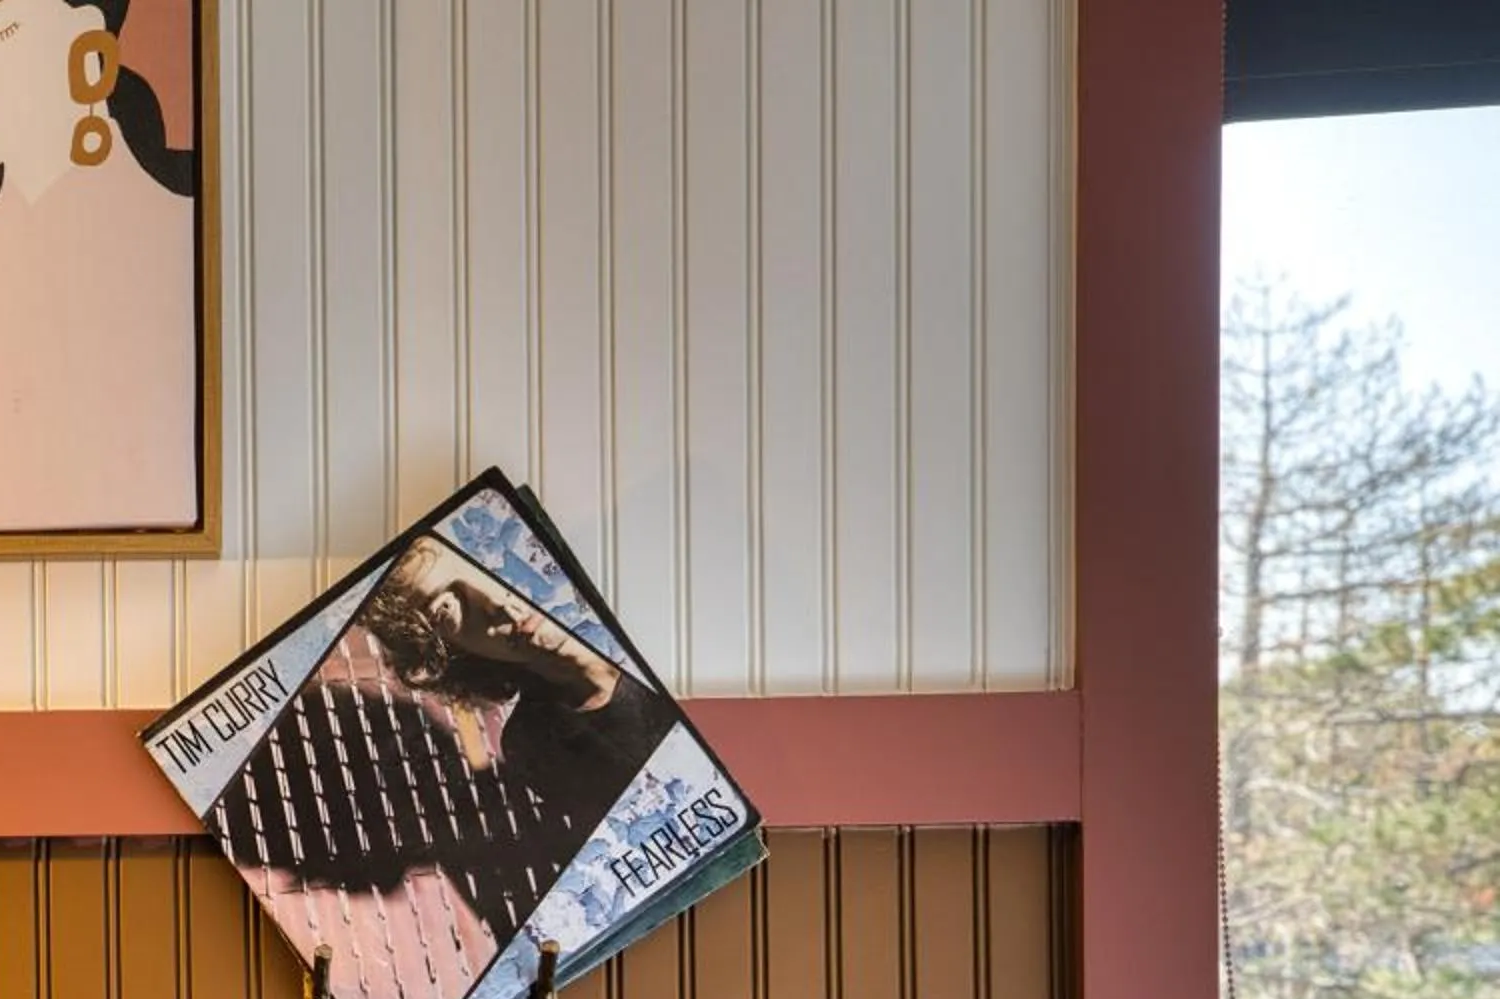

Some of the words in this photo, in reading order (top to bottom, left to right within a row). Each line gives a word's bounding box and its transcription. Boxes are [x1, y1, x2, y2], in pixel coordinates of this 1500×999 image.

[156, 719, 213, 774] TIM
[200, 658, 289, 742] CURRY
[609, 786, 739, 898] FEARLESS
